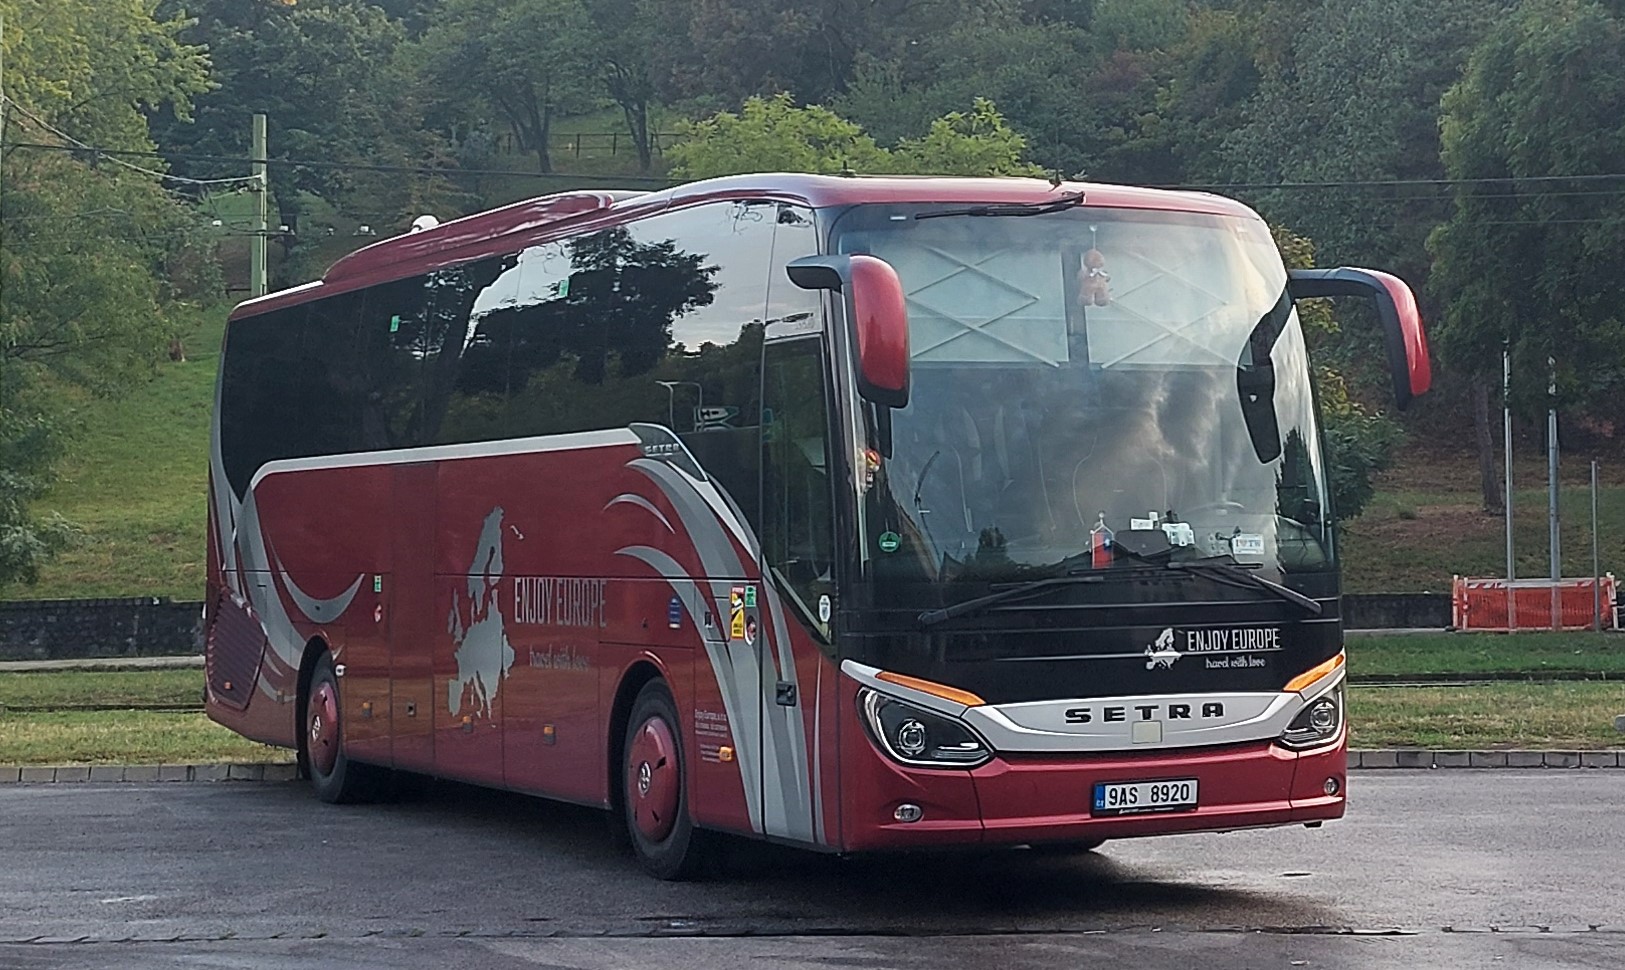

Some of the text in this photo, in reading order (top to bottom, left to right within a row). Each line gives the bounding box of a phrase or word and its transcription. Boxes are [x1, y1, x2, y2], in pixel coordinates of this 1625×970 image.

[514, 577, 607, 628] ENJOY EUROPE
[1187, 627, 1281, 651] ENJOY EUROPE
[1065, 702, 1224, 724] SETRA
[1108, 786, 1138, 806] 9AS
[1150, 783, 1190, 803] 8920
